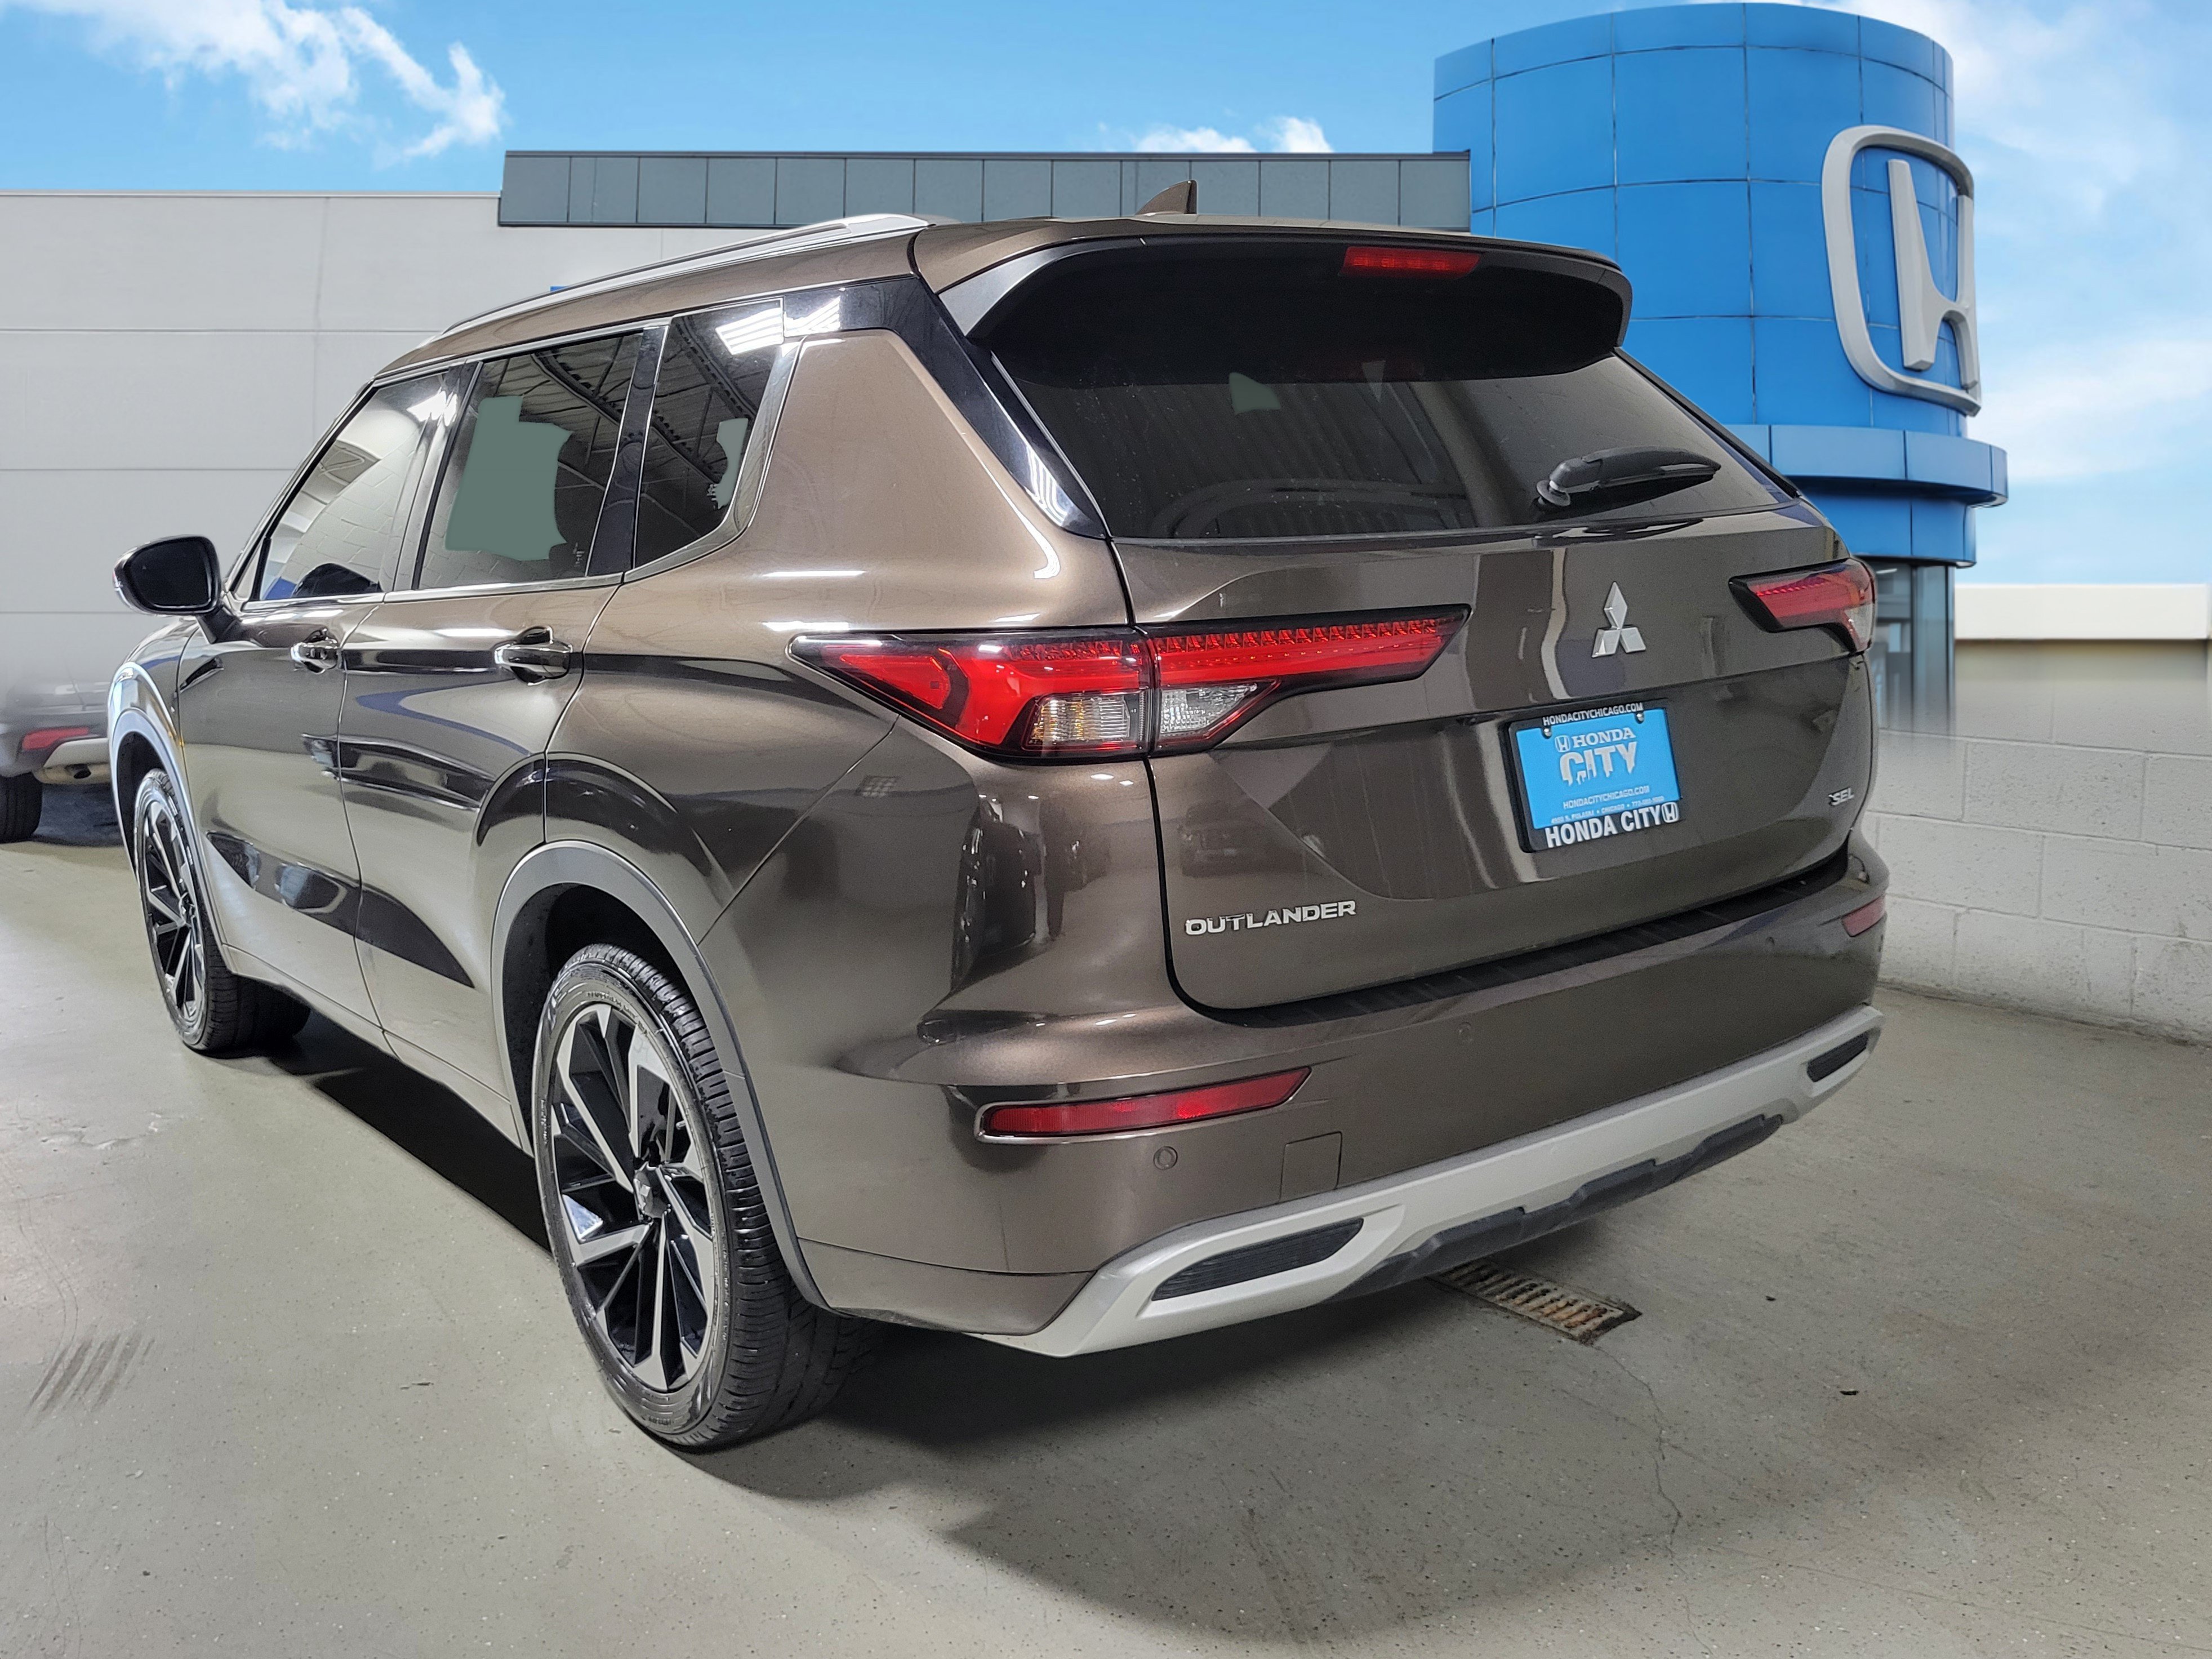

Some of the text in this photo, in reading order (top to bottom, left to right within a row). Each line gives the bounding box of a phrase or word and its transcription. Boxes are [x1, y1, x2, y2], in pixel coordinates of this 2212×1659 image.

[1542, 702, 1644, 726] HONDACITYCHICAGO.COM
[1572, 727, 1636, 748] HONDA
[1560, 741, 1637, 786] CITY
[1563, 785, 1649, 810] HONDACITYCHICAGO.COM
[1828, 788, 1854, 806] SEL
[1545, 815, 1618, 848] HONDA
[1621, 805, 1661, 832] CITY
[1185, 900, 1356, 935] OUTLANDER
